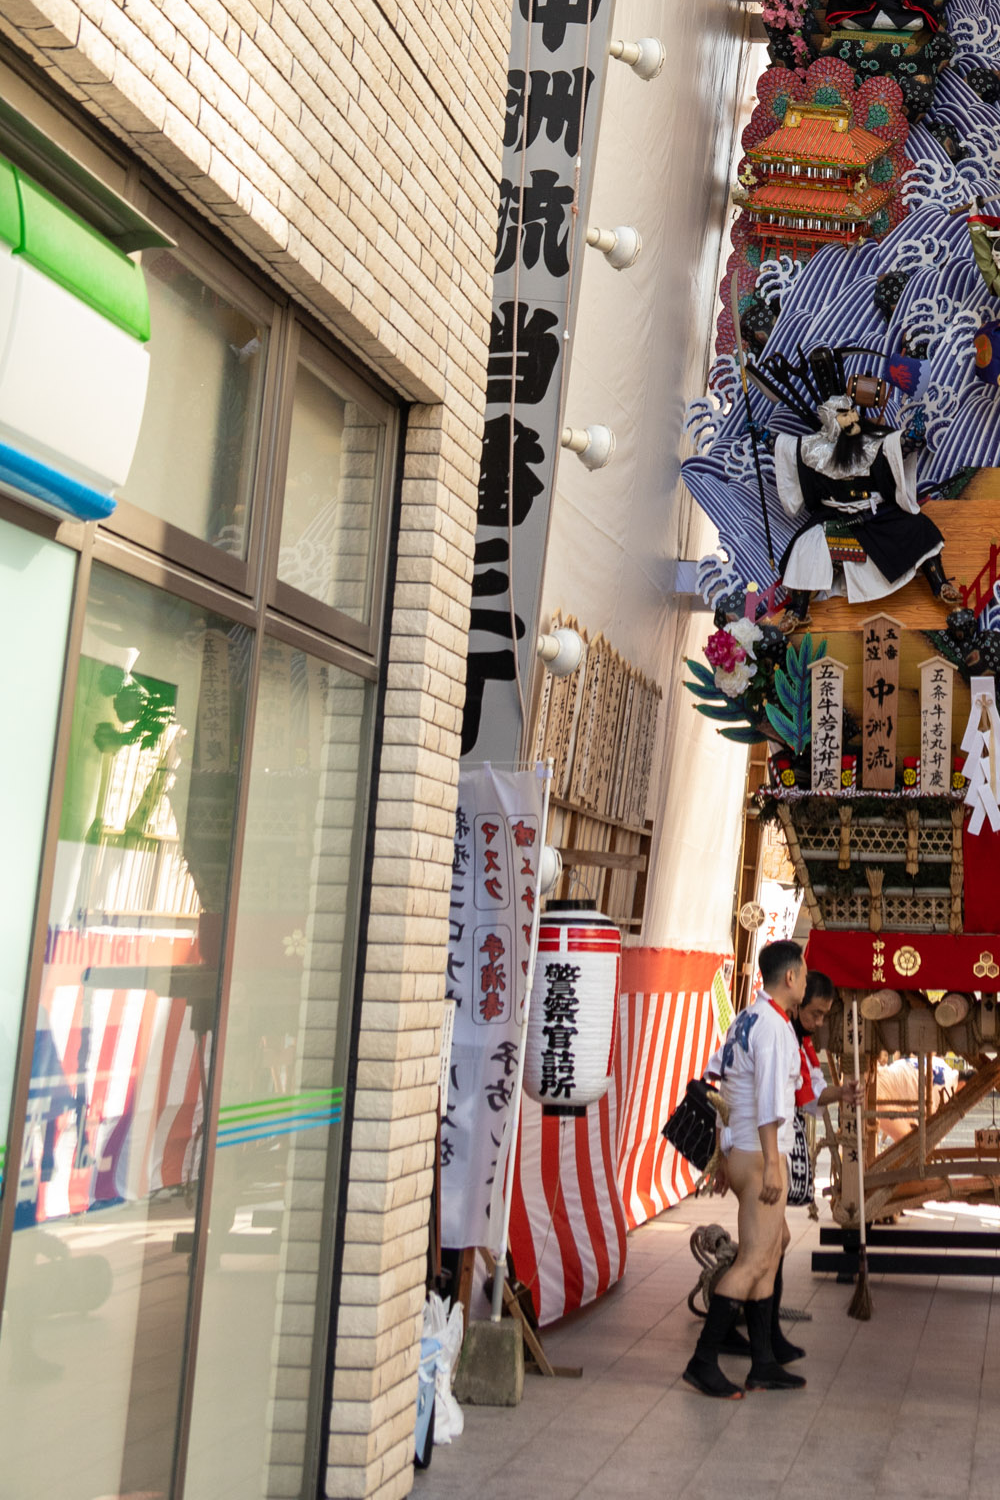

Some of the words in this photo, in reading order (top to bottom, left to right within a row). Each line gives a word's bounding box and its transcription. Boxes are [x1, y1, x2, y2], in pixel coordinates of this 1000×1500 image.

[865, 629, 881, 662] 山笠
[883, 628, 898, 660] 五番
[816, 664, 840, 790] 五条牛若丸弁慶
[866, 677, 896, 770] 中洲流
[929, 668, 948, 788] 五条牛若丸弁慶
[480, 821, 503, 901] マスク
[872, 939, 887, 983] 中洲流
[539, 963, 582, 1099] 警察官詰所
